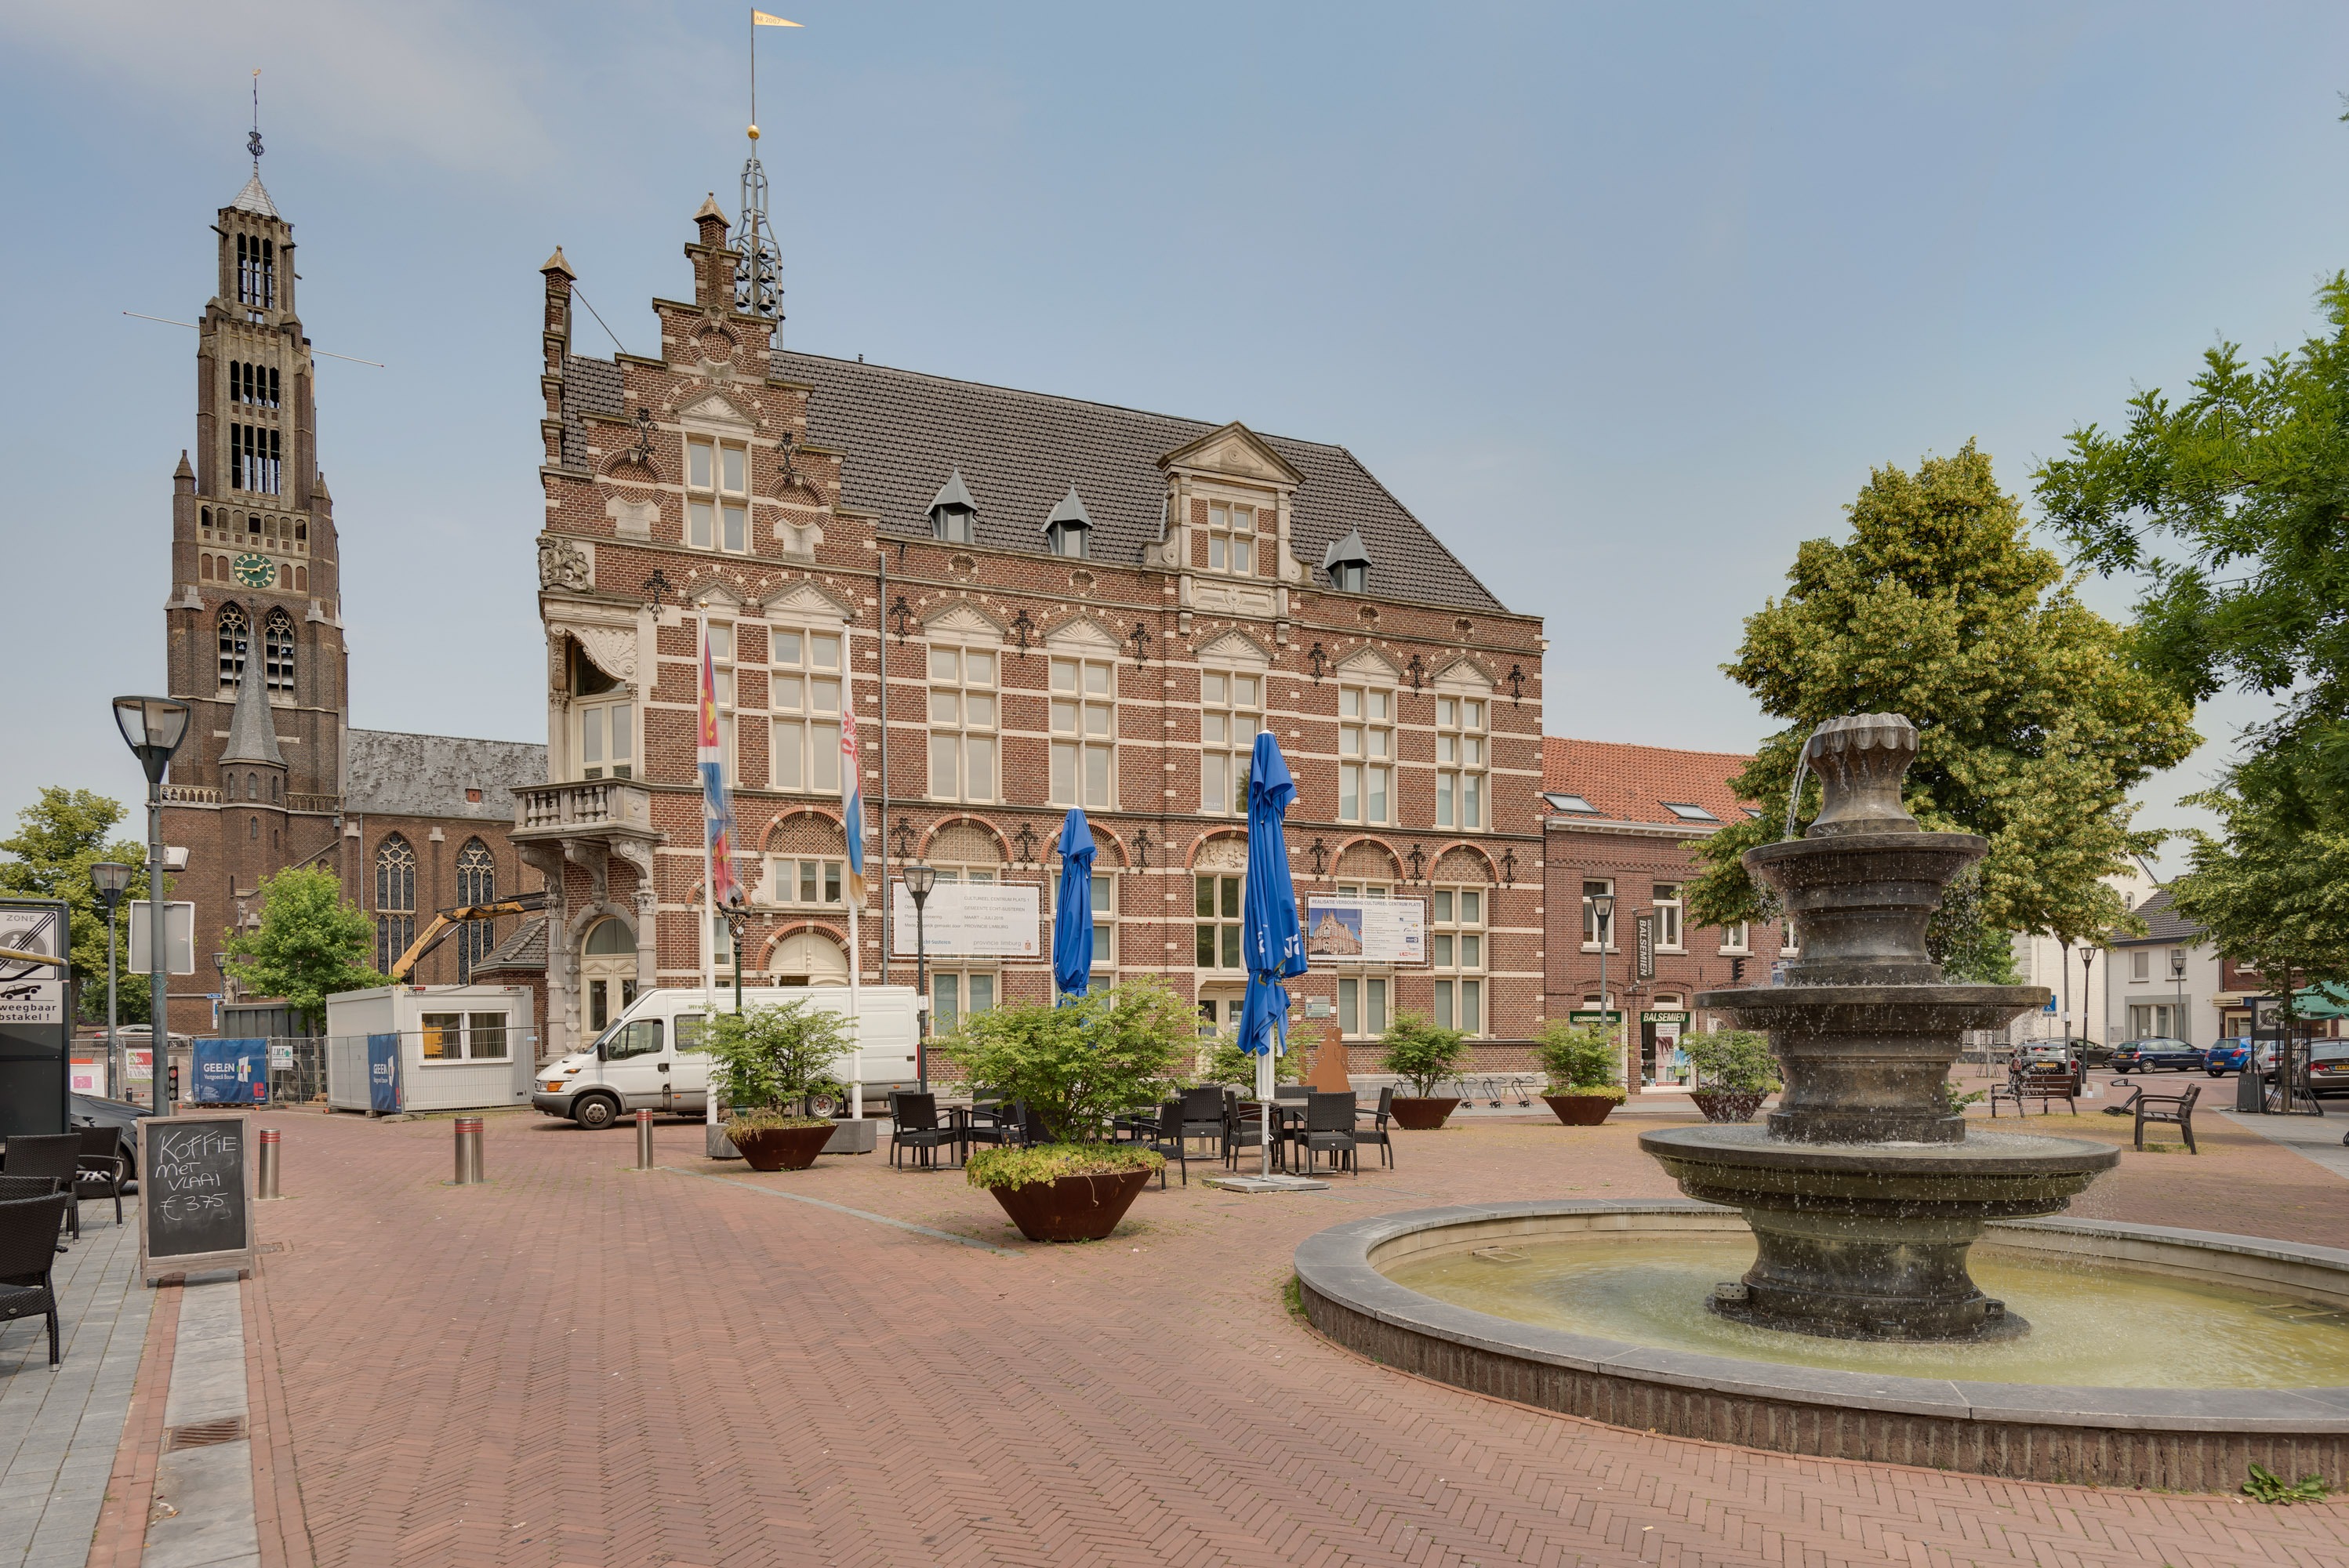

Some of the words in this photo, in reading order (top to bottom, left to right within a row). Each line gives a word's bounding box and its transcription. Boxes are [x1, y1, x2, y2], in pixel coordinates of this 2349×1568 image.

[765, 16, 781, 25] 2007
[1639, 920, 1648, 976] BALSEMIEN
[1643, 1013, 1686, 1022] BALSEMIEN
[203, 1063, 235, 1072] GEELEN
